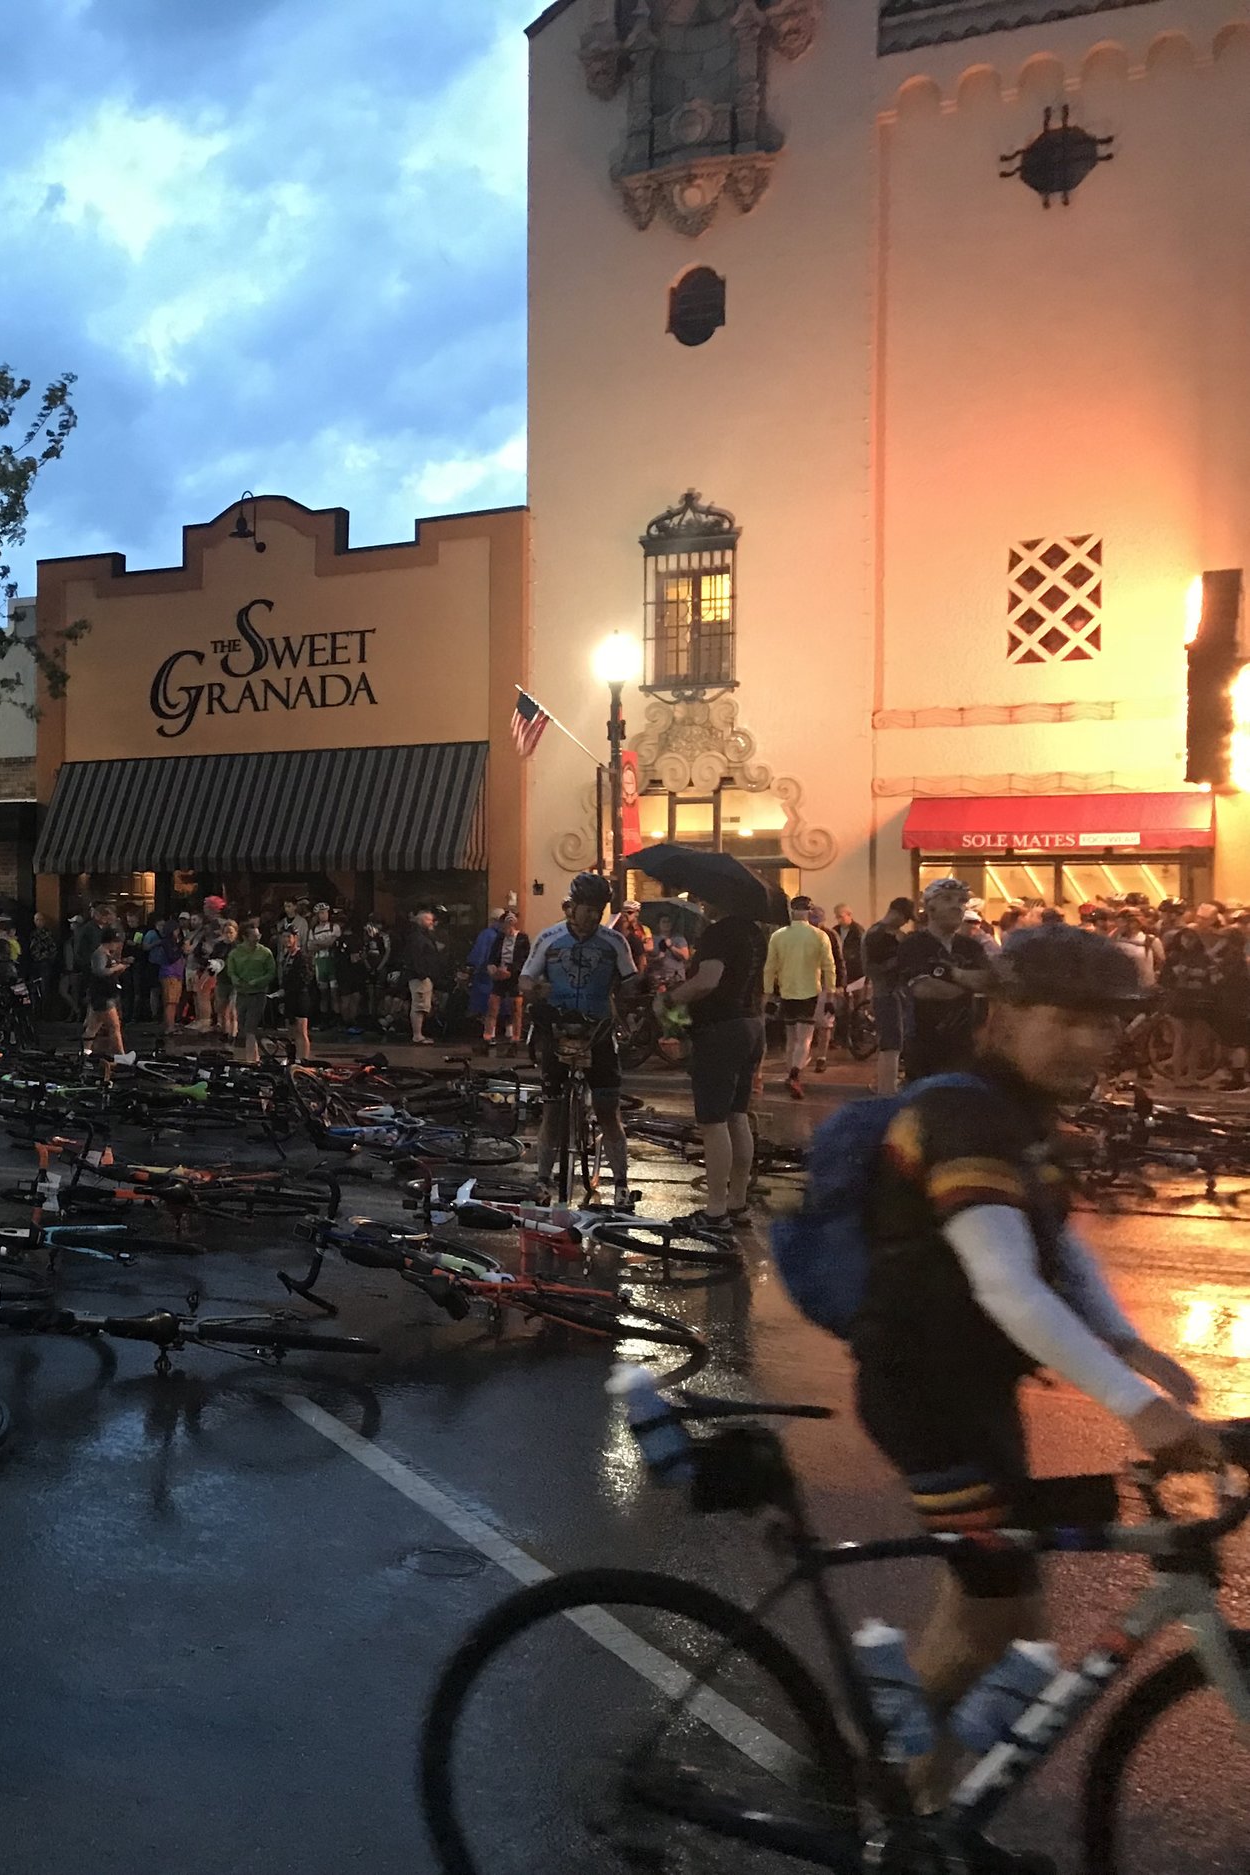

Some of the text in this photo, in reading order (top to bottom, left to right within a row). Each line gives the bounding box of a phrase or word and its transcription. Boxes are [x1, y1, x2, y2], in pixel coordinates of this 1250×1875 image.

[210, 598, 376, 678] THE SWEET
[150, 650, 378, 738] GRANADA
[962, 834, 1007, 848] SOLE
[1012, 833, 1076, 848] MATES
